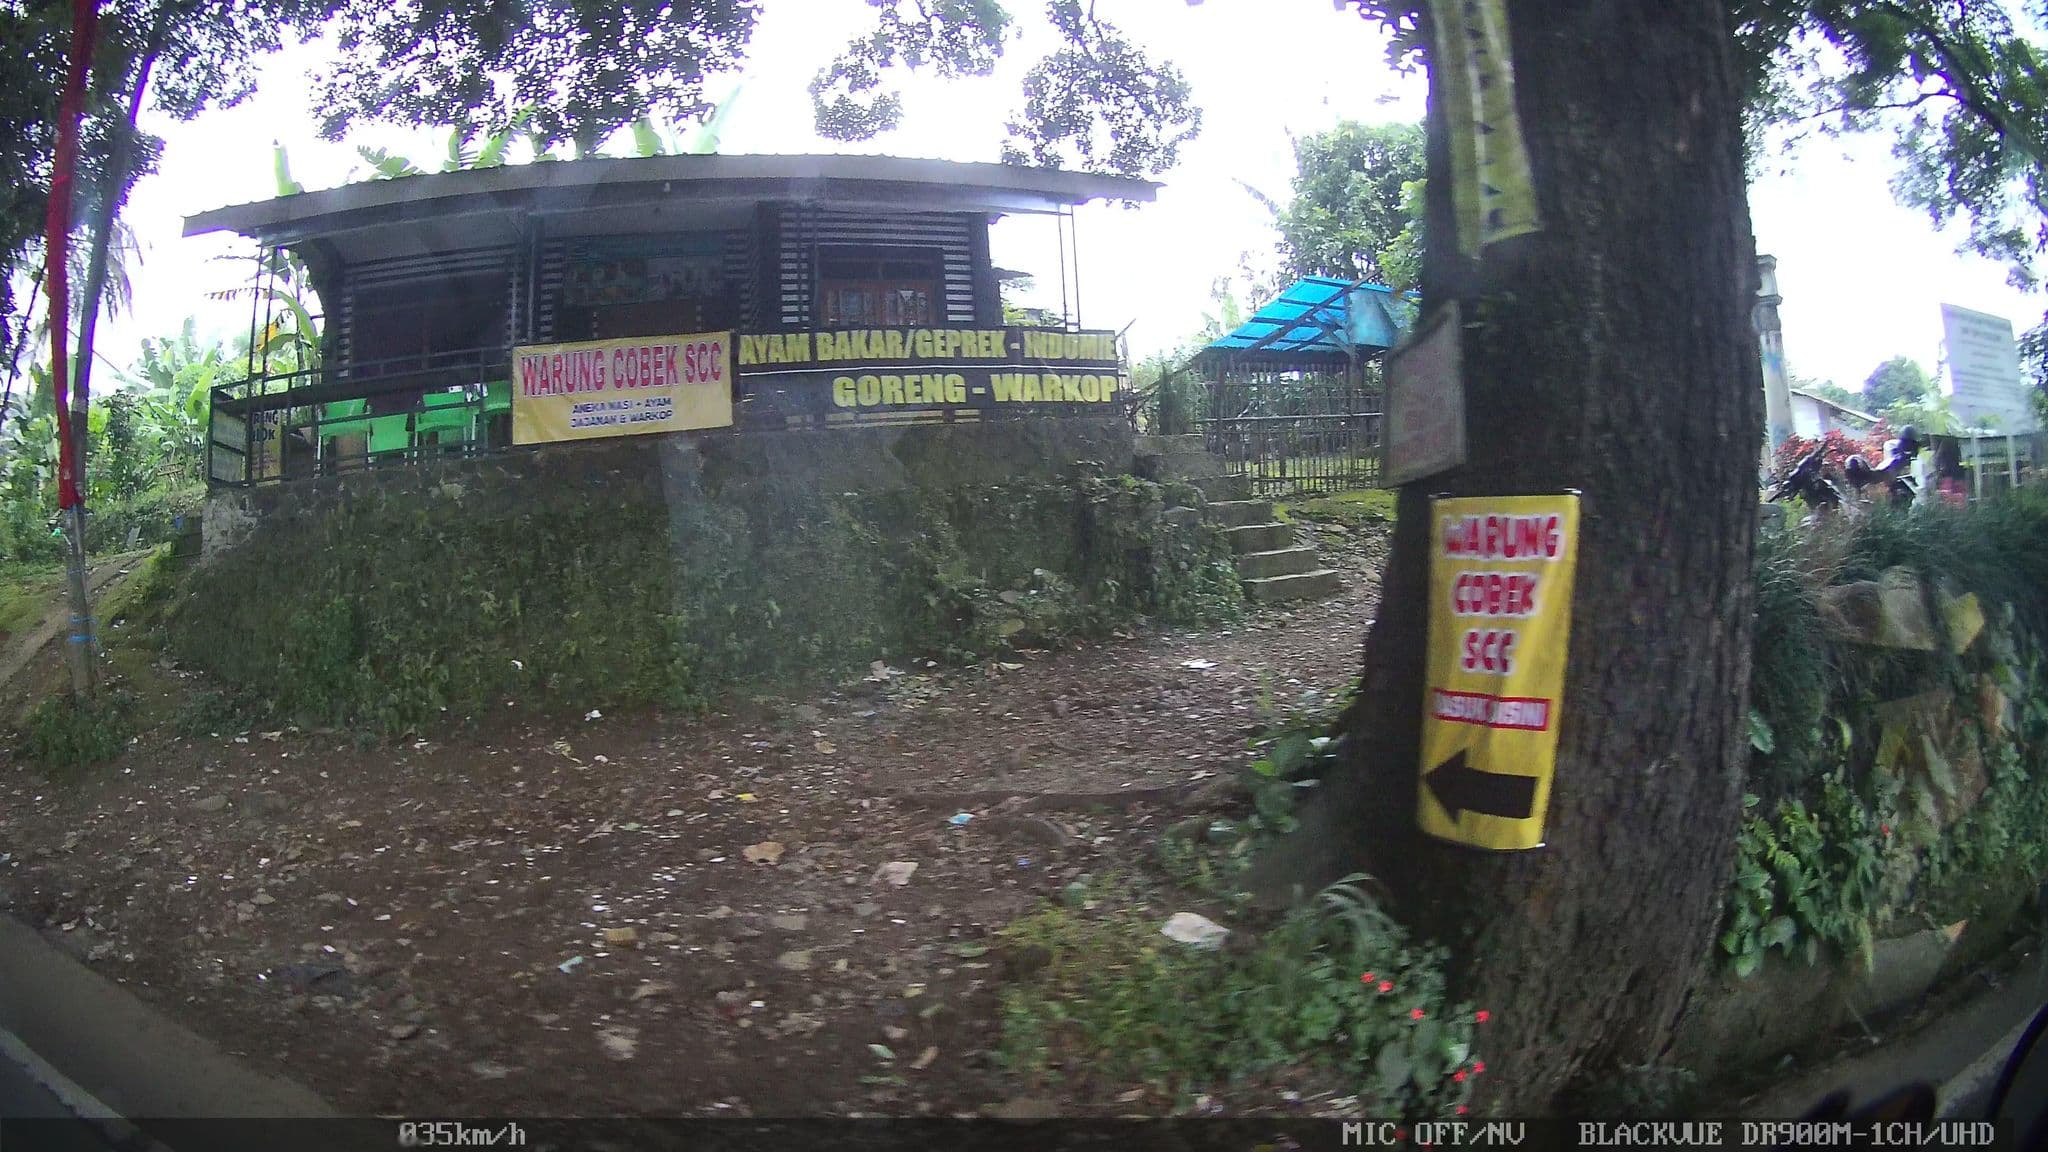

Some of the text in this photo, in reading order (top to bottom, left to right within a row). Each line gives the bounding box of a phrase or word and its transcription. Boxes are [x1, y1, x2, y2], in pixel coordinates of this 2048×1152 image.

[738, 334, 811, 365] AYAM
[815, 329, 1008, 361] BAKAR/GEPREK
[521, 341, 723, 396] WARUNG COBEK SCC
[572, 402, 606, 414] ANEKA
[644, 398, 672, 408] AYAM
[832, 374, 966, 407] GORENG
[990, 373, 1117, 403] WARKOP
[630, 410, 673, 422] WARKOP
[1443, 515, 1560, 558] WARUNG
[1454, 573, 1536, 614] COBEK
[1464, 630, 1513, 673] SCC
